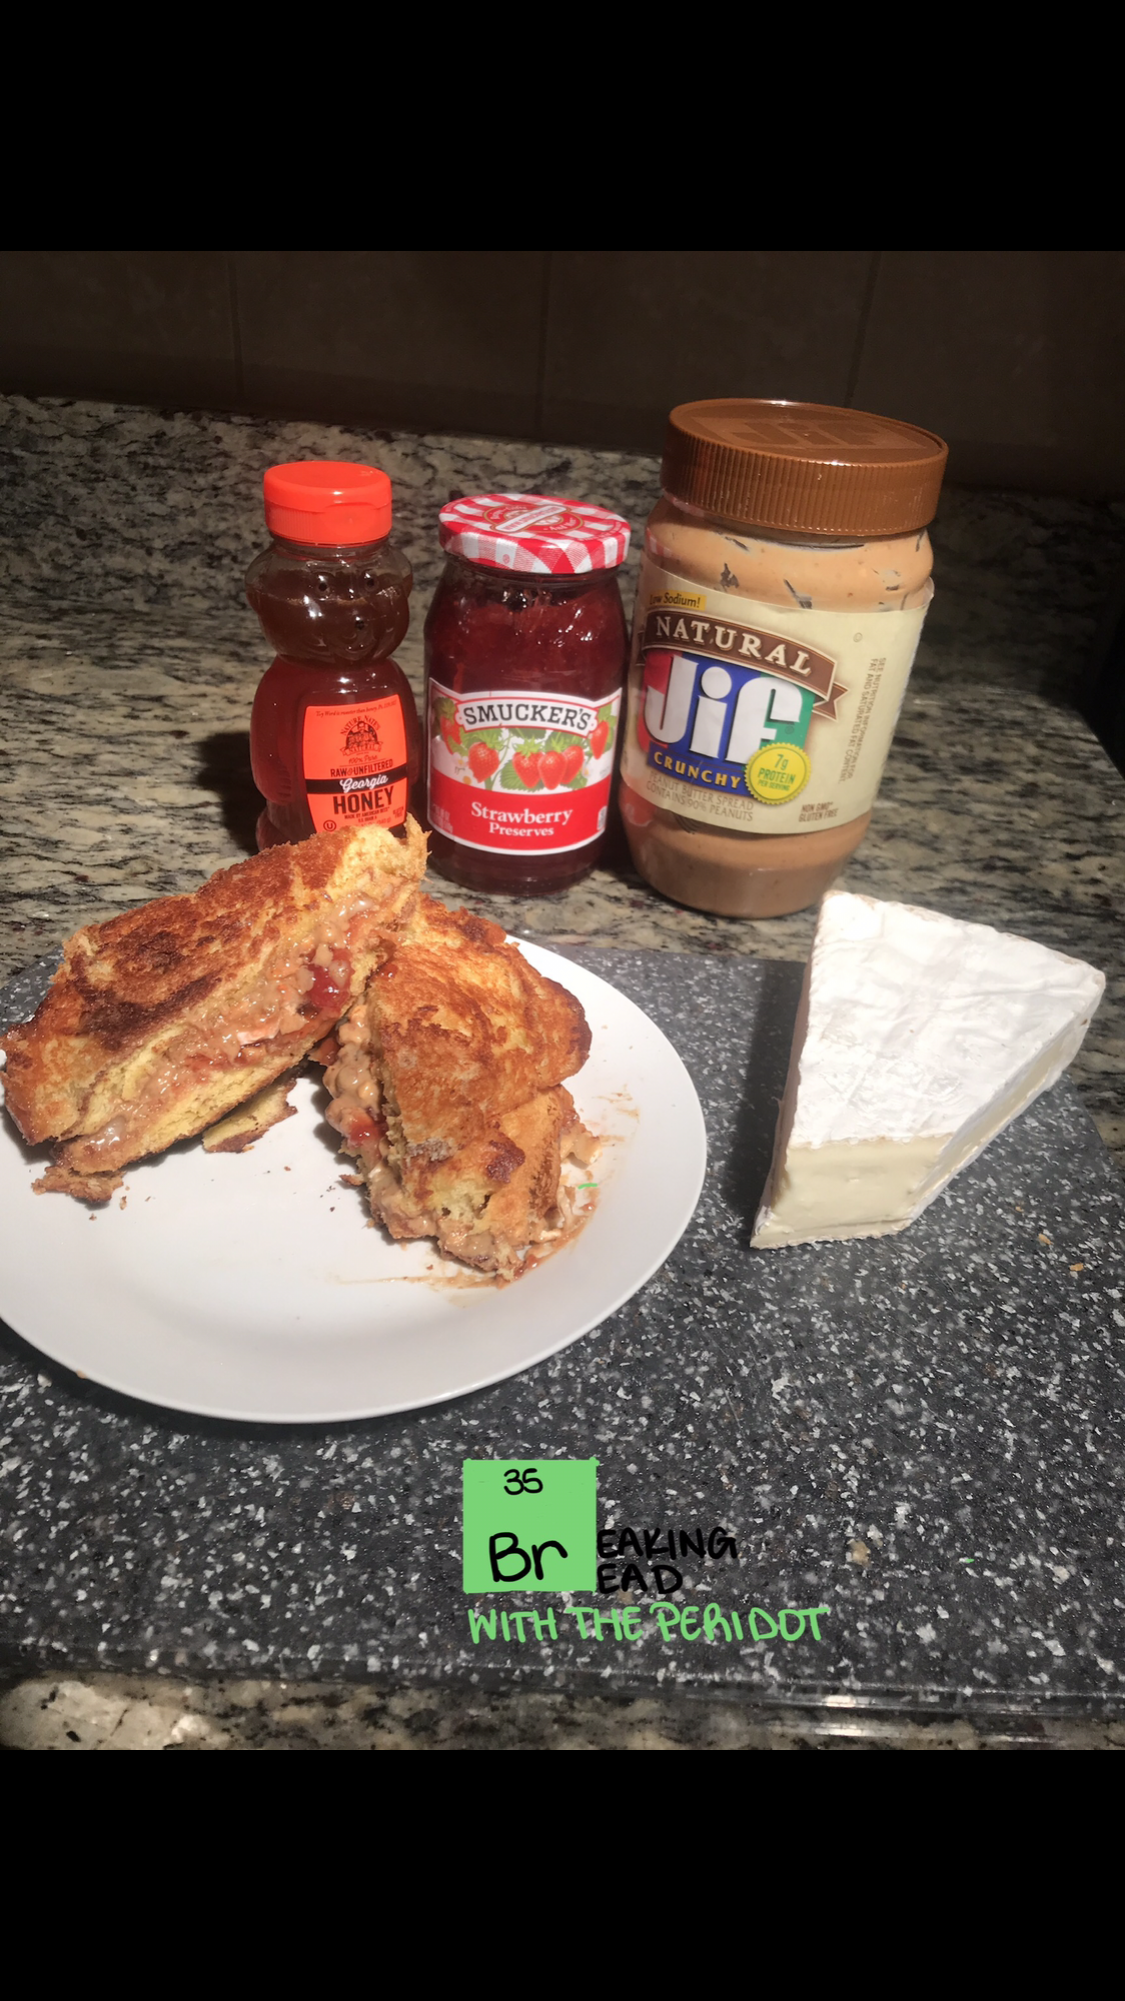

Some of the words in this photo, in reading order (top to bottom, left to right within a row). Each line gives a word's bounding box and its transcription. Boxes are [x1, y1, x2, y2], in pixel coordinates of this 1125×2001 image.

[663, 592, 701, 608] Sodium!
[656, 616, 812, 675] NATURAL
[863, 673, 874, 690] AND
[463, 704, 591, 730] SMUCKER'S
[644, 654, 802, 765] Jif
[654, 752, 740, 789] CRUNCHY
[774, 754, 789, 771] 7g
[339, 774, 388, 794] Georgia
[757, 767, 796, 785] PROTEIN
[332, 786, 394, 815] HONEY
[646, 780, 685, 805] CONTAINS
[687, 799, 707, 812] 90%
[709, 804, 753, 821] PEANUTS
[650, 770, 678, 790] PEANUT
[682, 784, 713, 803] BUTTER
[716, 795, 754, 811] SPREAD
[471, 801, 573, 826] Strawberry
[799, 811, 823, 822] GLUTEN
[489, 822, 554, 837] Preserves
